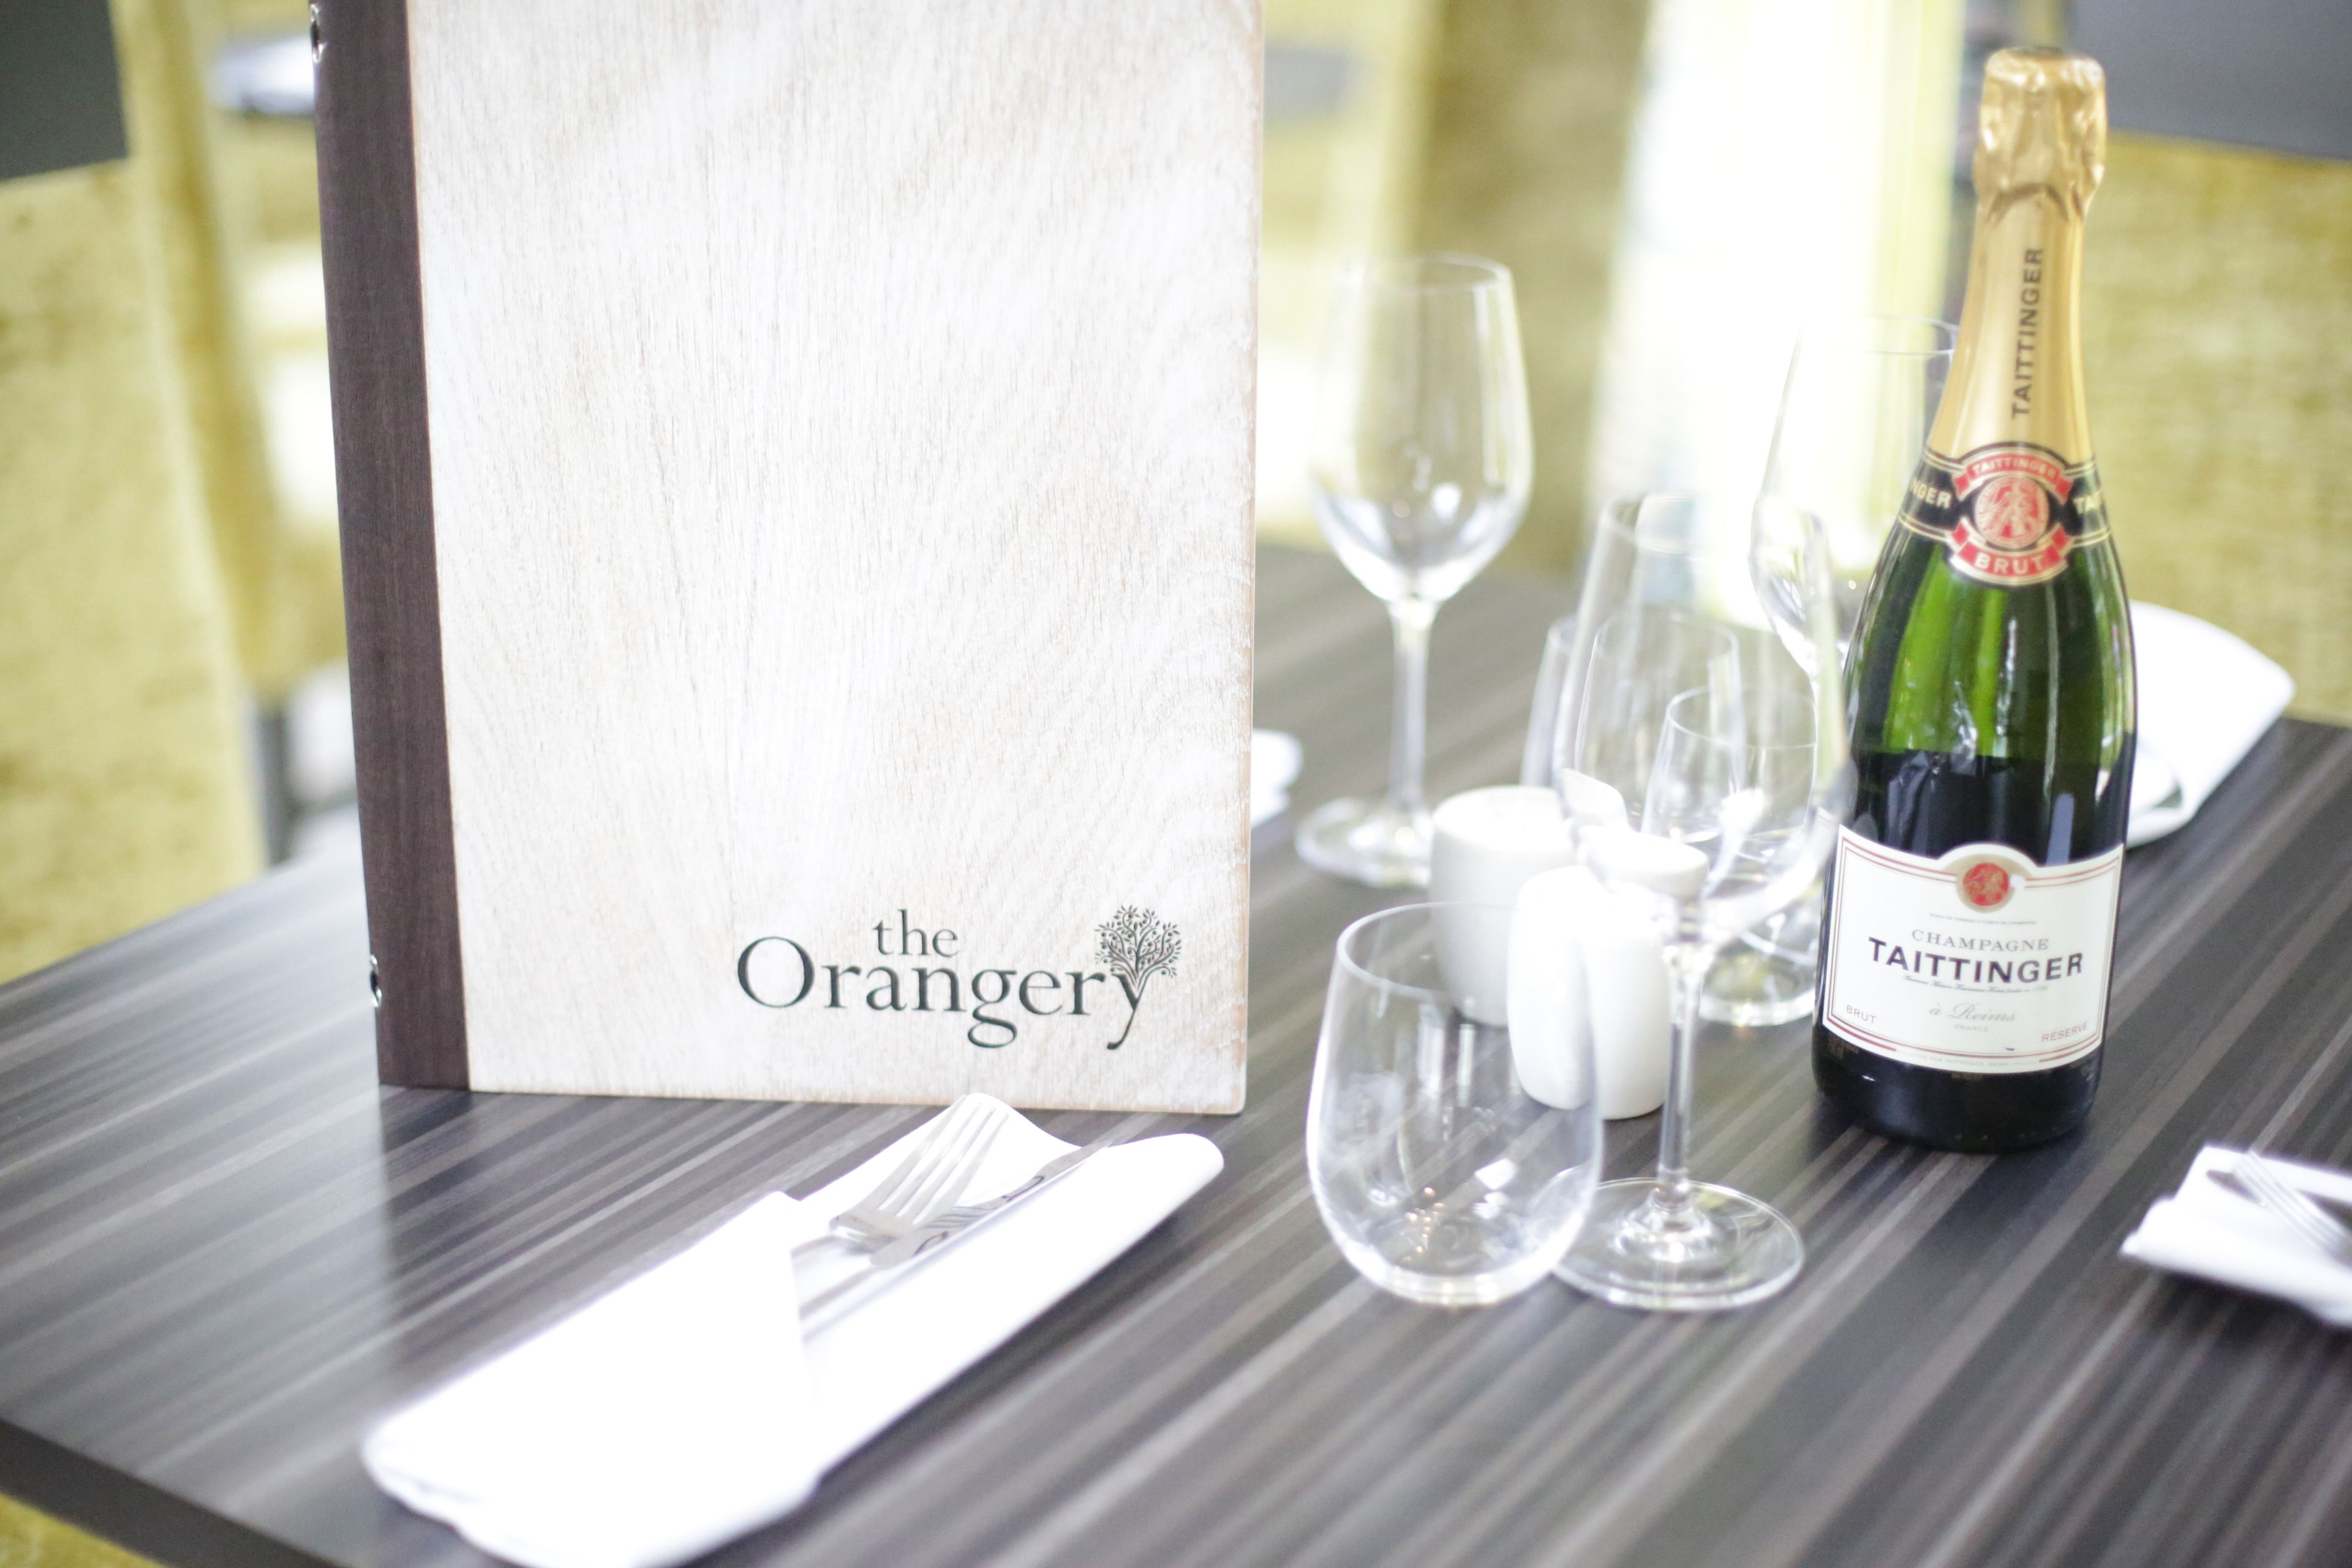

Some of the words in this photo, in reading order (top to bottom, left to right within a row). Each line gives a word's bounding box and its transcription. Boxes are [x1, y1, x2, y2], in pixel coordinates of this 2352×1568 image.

[2011, 247, 2043, 419] TAITTINGER
[1974, 554, 2045, 574] BRUT
[872, 908, 960, 958] the
[1912, 929, 2049, 952] CHAMPAGNE
[1868, 936, 2083, 984] TAITTINGER
[737, 935, 1158, 1051] Orangery
[1846, 1005, 1877, 1024] BRUT
[1929, 1001, 1942, 1016] à
[1947, 1003, 2016, 1022] Reims
[1954, 1023, 1989, 1032] FRANCE
